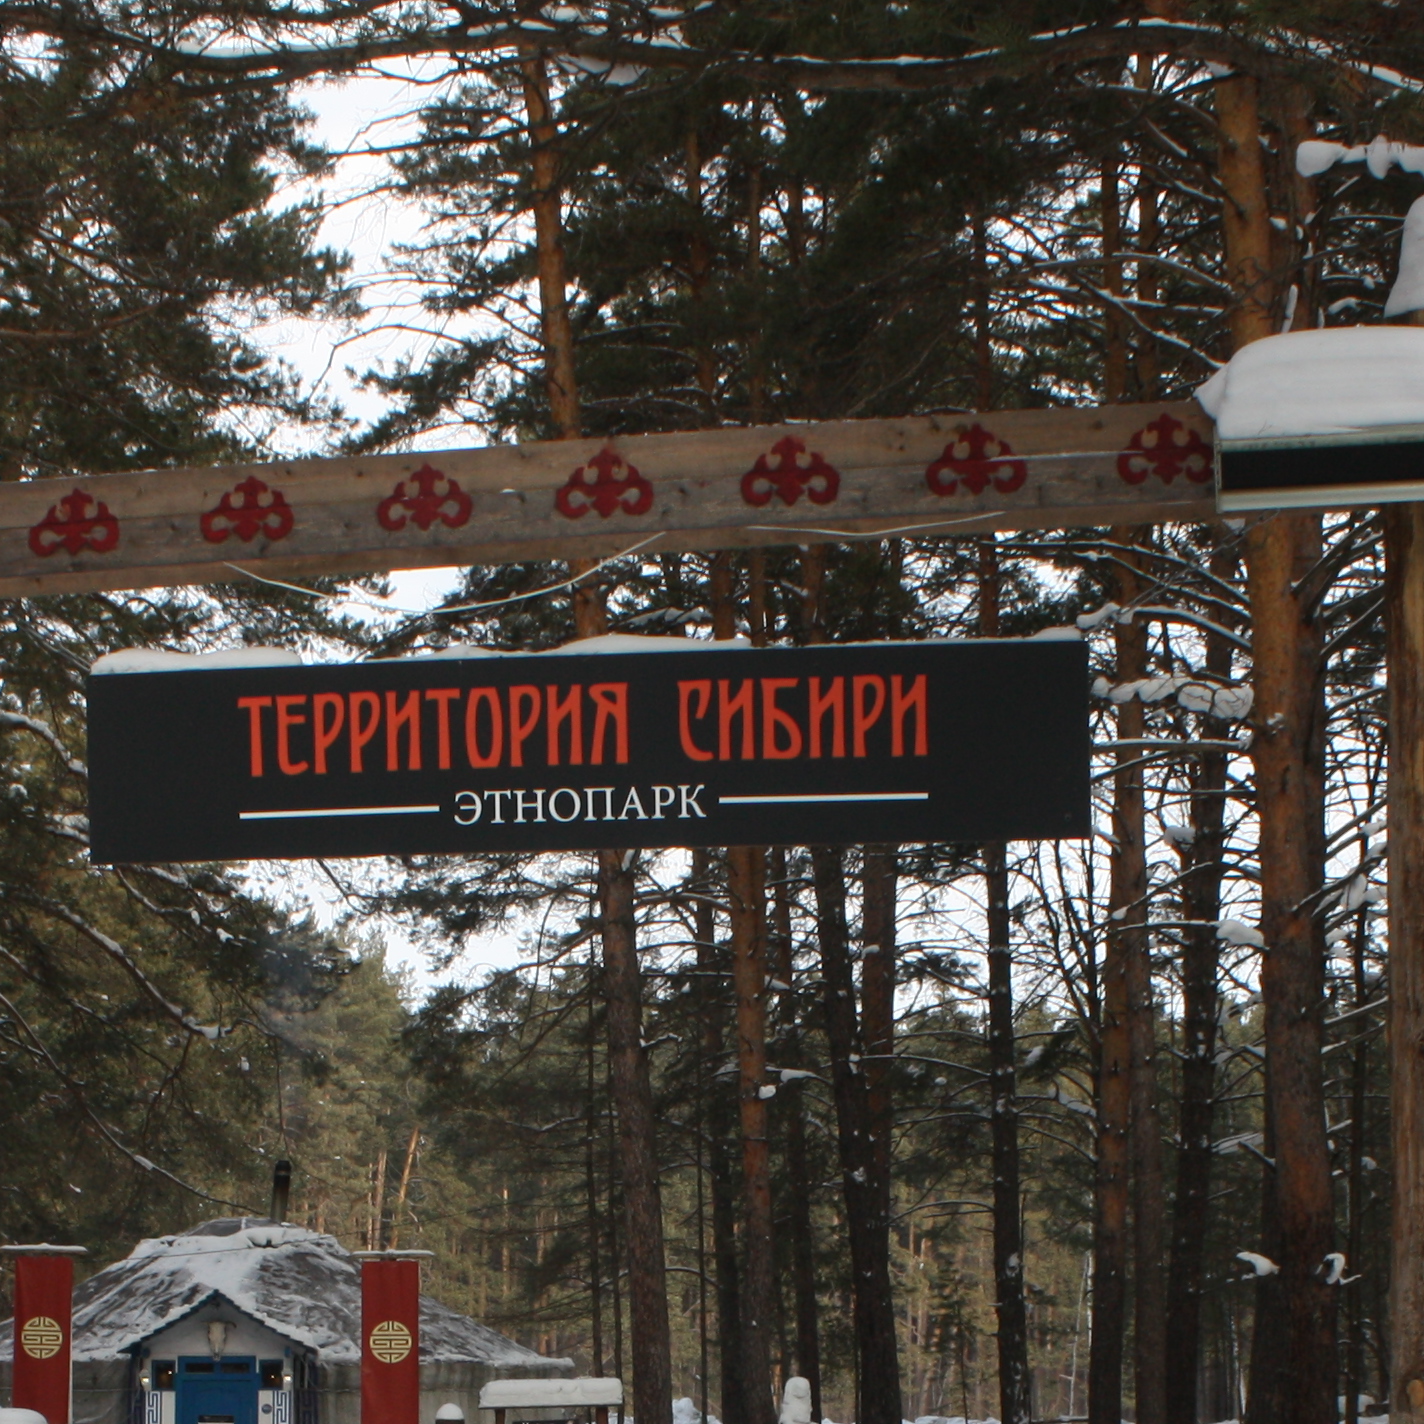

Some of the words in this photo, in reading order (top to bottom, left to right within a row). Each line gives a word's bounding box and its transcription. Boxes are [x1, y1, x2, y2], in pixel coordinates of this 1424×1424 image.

[237, 682, 629, 777] ТЕРРИТОРИЯ
[676, 674, 927, 761] СИБИРИ
[454, 783, 707, 825] ЭТНОПАРК
